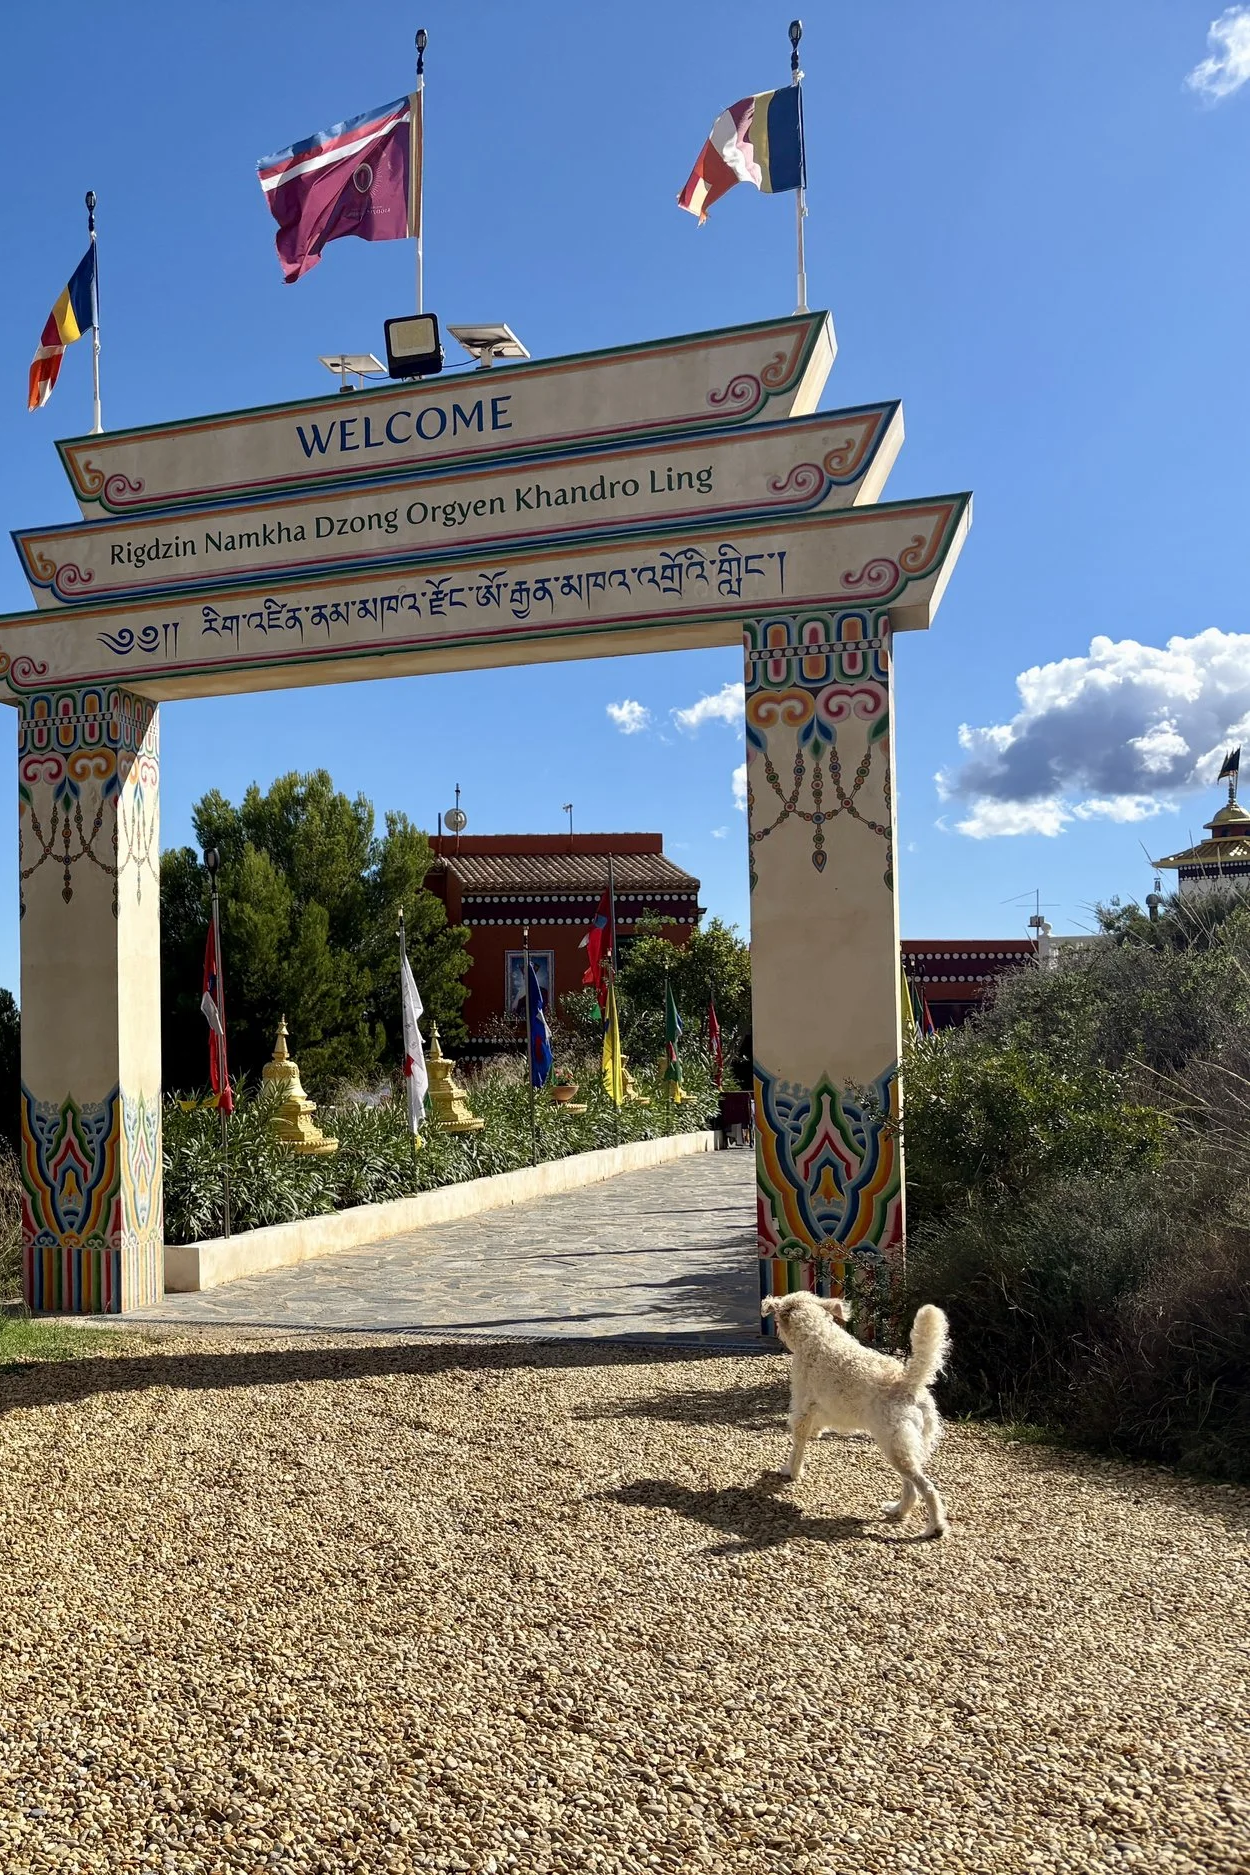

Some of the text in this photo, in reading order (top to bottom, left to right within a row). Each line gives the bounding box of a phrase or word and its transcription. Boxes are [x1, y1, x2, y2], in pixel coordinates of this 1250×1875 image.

[296, 395, 513, 458] WELCOME
[110, 465, 713, 568] Rigdzin Namkha Dzong Orgyen Khandro Ling
